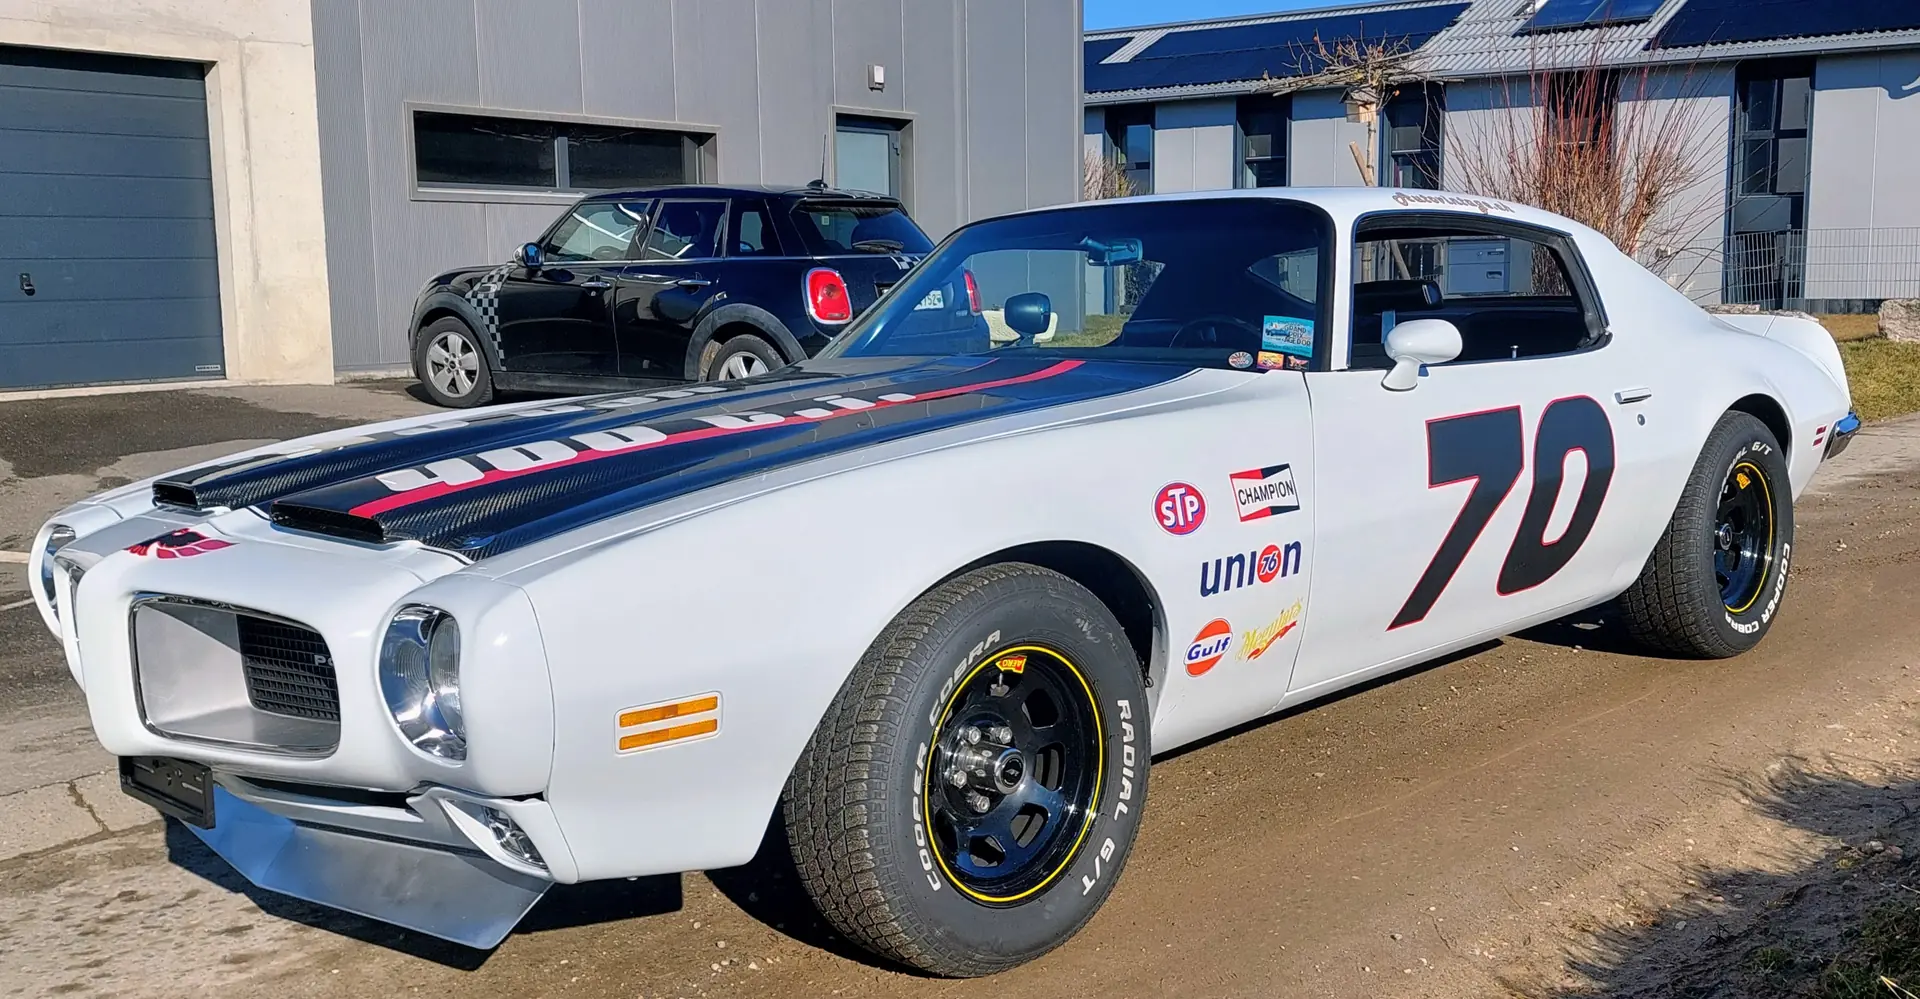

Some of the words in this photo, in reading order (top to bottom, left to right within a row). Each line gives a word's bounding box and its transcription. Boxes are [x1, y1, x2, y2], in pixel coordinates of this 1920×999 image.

[1751, 441, 1773, 456] G/T
[1160, 487, 1201, 529] STP
[1237, 479, 1295, 506] CHAMPION
[1385, 395, 1616, 632] 70
[1261, 552, 1277, 575] 76
[1760, 542, 1791, 625] COOPER
[1186, 636, 1231, 661] Gulf
[912, 741, 942, 892] COOPER
[929, 629, 1001, 727] COBRA
[1114, 699, 1136, 821] RADIAL
[1081, 836, 1116, 896] G/T
